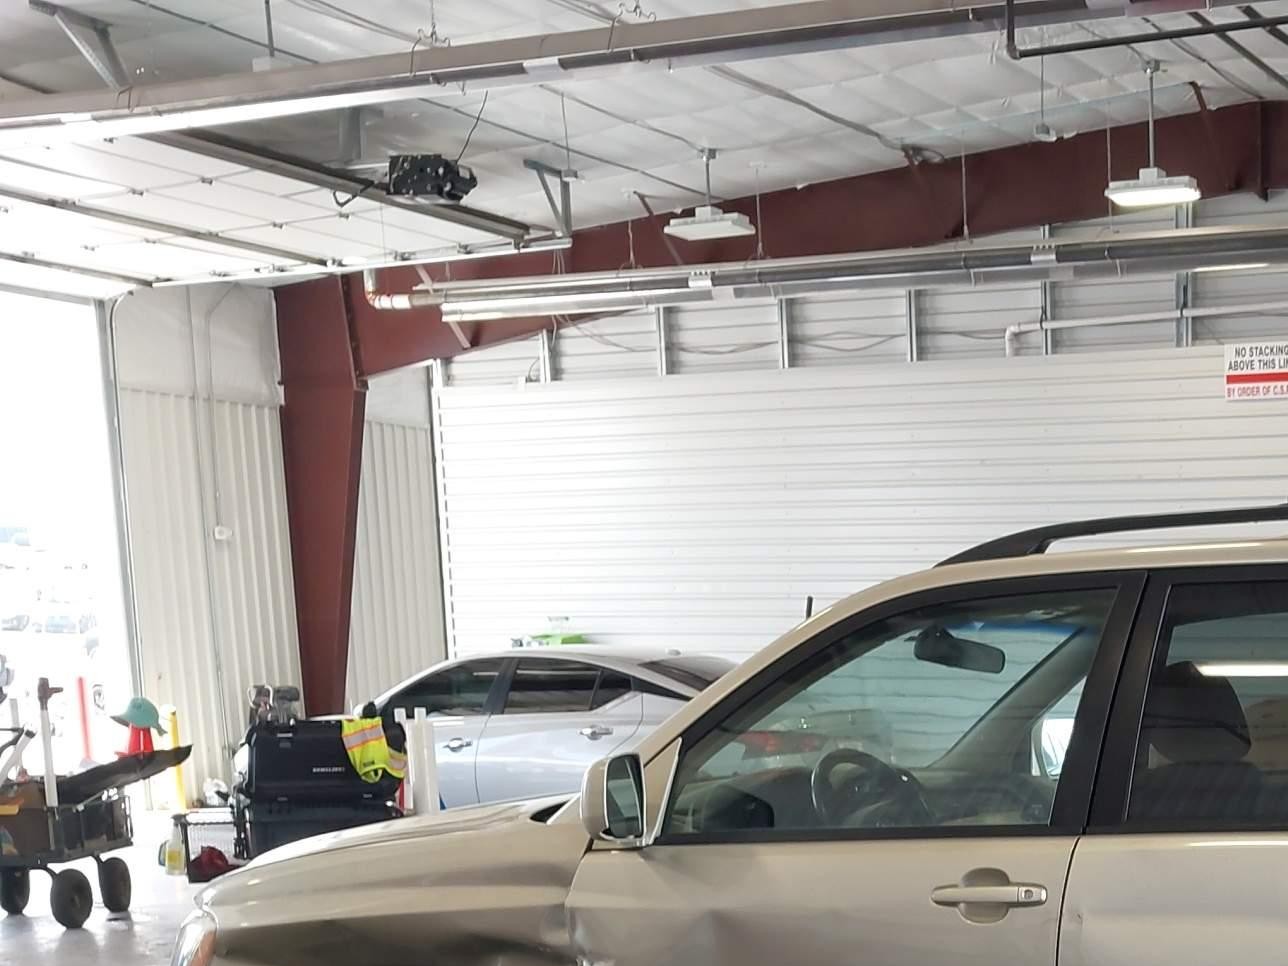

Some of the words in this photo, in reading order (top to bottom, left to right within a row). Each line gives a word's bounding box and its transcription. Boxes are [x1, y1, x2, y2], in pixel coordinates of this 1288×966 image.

[1234, 347, 1246, 358] NO
[1249, 345, 1288, 357] STACKING
[1228, 360, 1255, 371] ABOVE
[1258, 359, 1276, 370] THIS
[1227, 387, 1235, 398] BY
[1237, 386, 1260, 397] ORDER
[1262, 385, 1271, 396] OF
